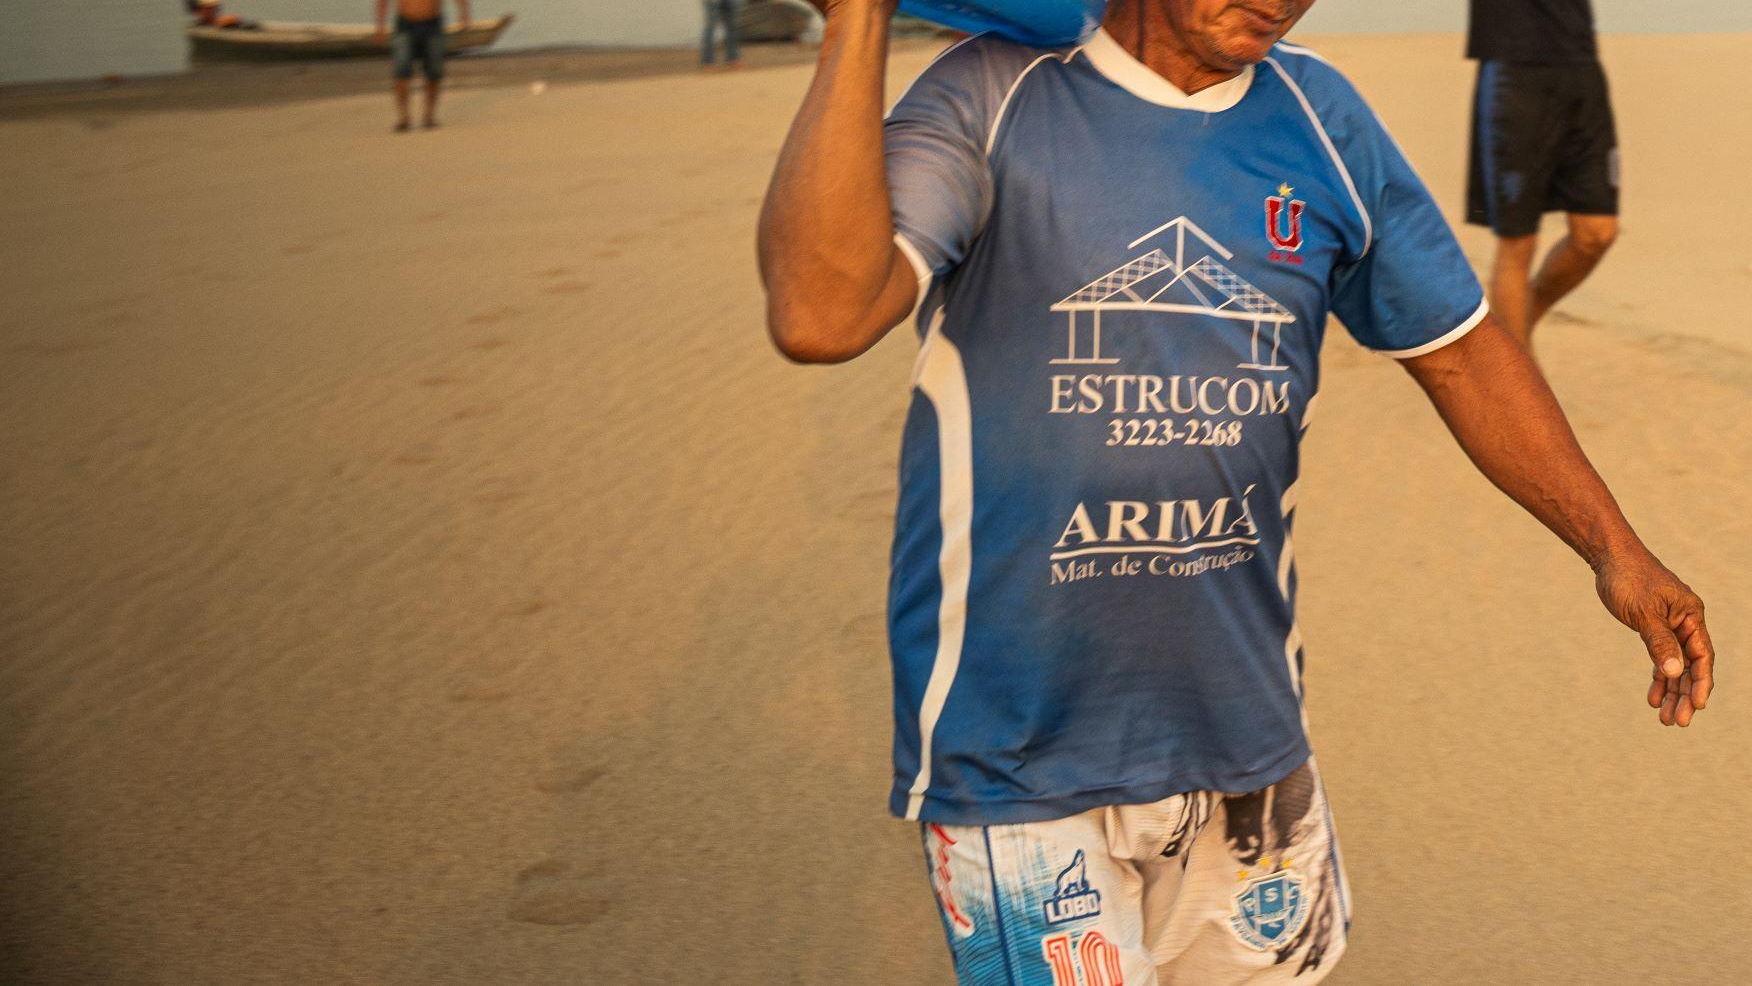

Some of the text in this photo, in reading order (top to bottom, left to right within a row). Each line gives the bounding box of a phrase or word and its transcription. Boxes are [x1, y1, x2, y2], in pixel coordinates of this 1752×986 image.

[1049, 374, 1291, 416] ESTRUCOM
[1105, 418, 1243, 447] 3223-2268
[1052, 483, 1258, 548] ARIMÁ
[1050, 560, 1102, 586] Mat.
[1111, 554, 1142, 578] de
[1046, 894, 1099, 923] LOBO
